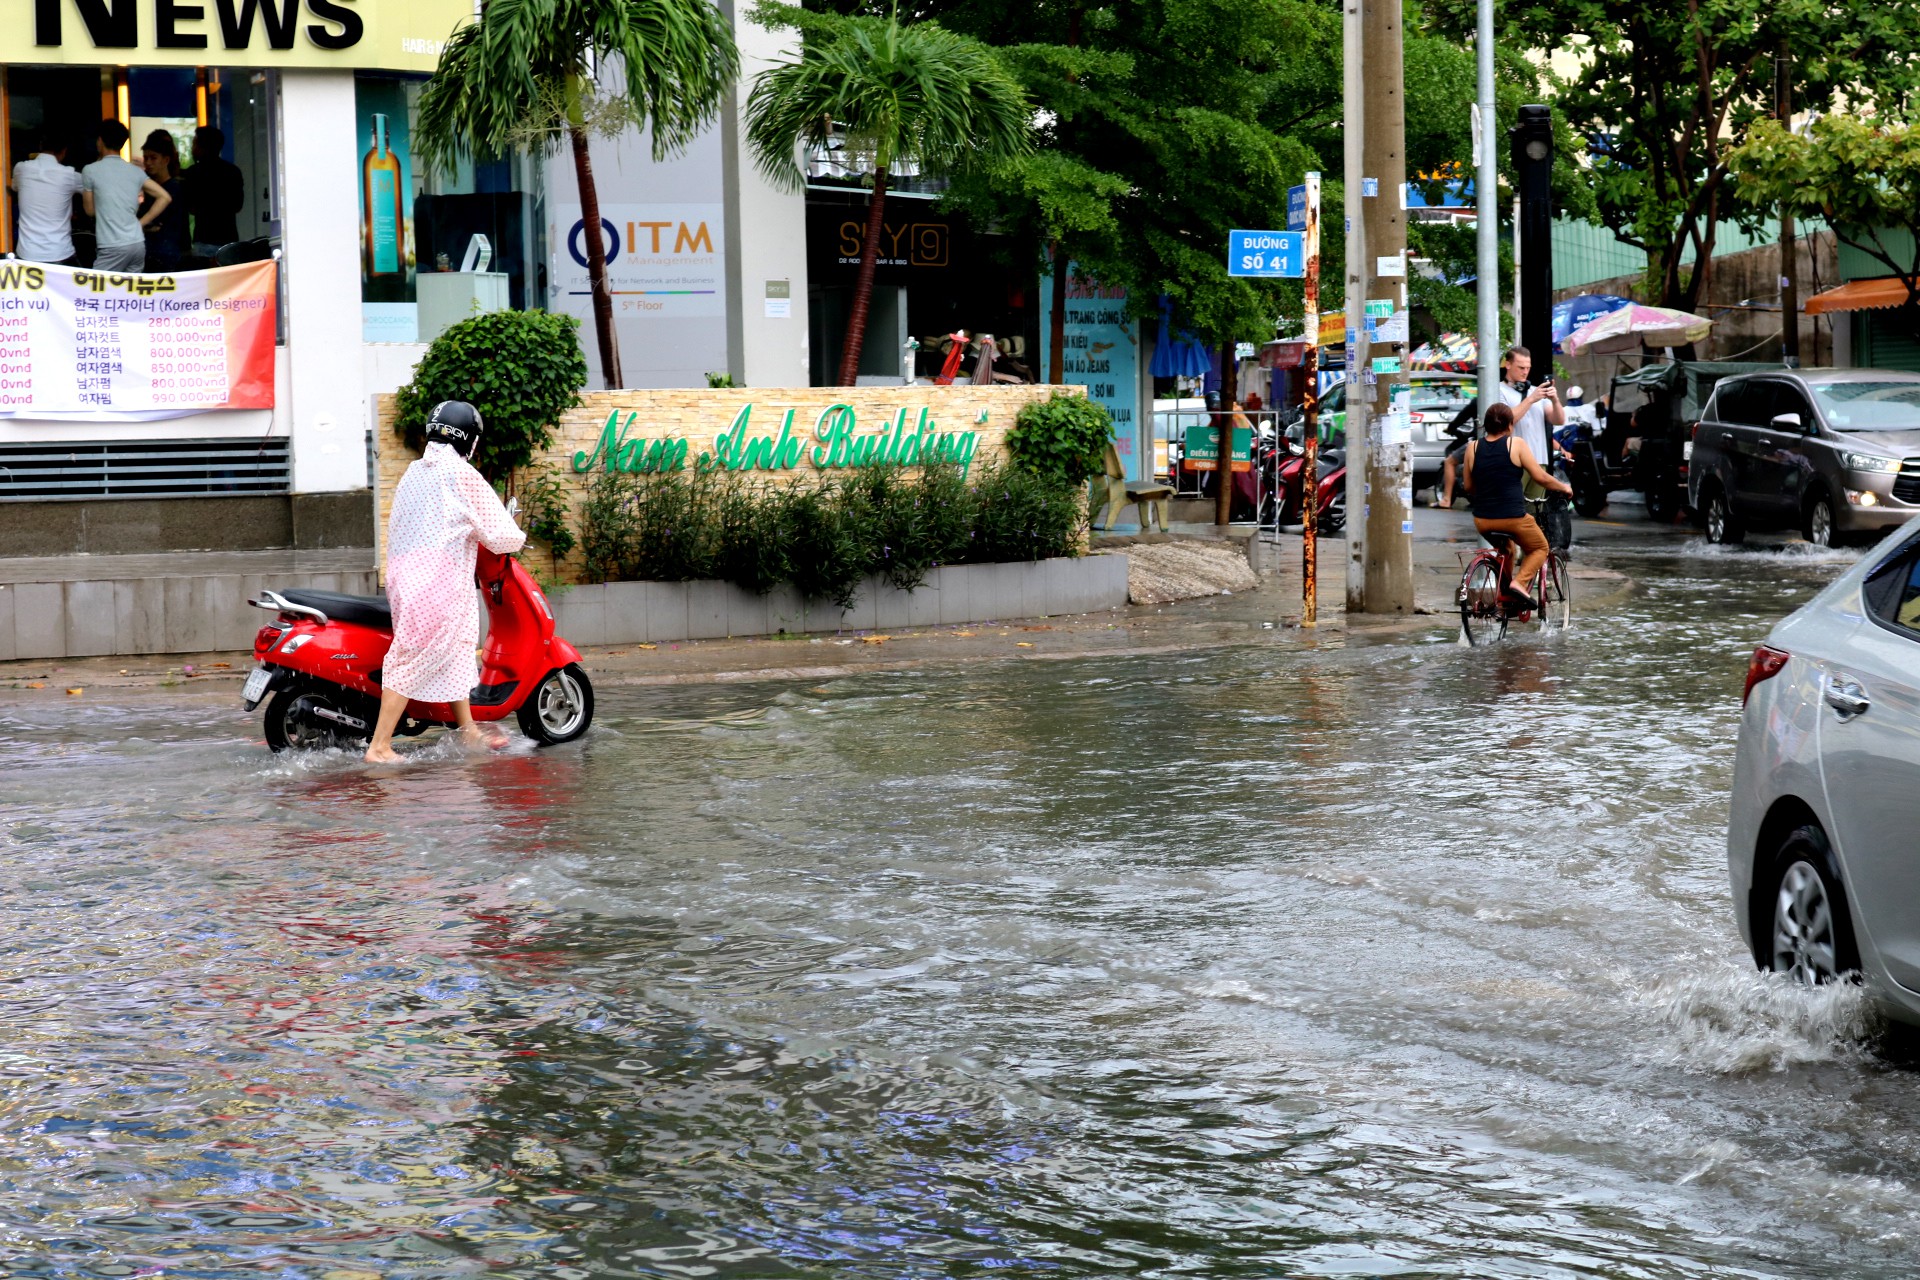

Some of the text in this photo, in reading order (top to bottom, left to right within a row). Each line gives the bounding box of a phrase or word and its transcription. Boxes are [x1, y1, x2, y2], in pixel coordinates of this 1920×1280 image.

[35, 0, 363, 49] NEWS
[627, 221, 714, 253] ITM
[1243, 235, 1289, 250] ĐƯỜNG
[627, 256, 714, 266] Management
[1241, 251, 1288, 270] SỐ 41
[27, 298, 50, 312] vụ)
[74, 297, 267, 312] 한국 디자이너 (Korea Designer)
[637, 300, 664, 311] Floor
[1069, 311, 1095, 324] TRANG
[1087, 359, 1110, 373] JEANS
[1106, 384, 1115, 398] MI
[571, 403, 982, 483] Nam Anh Building
